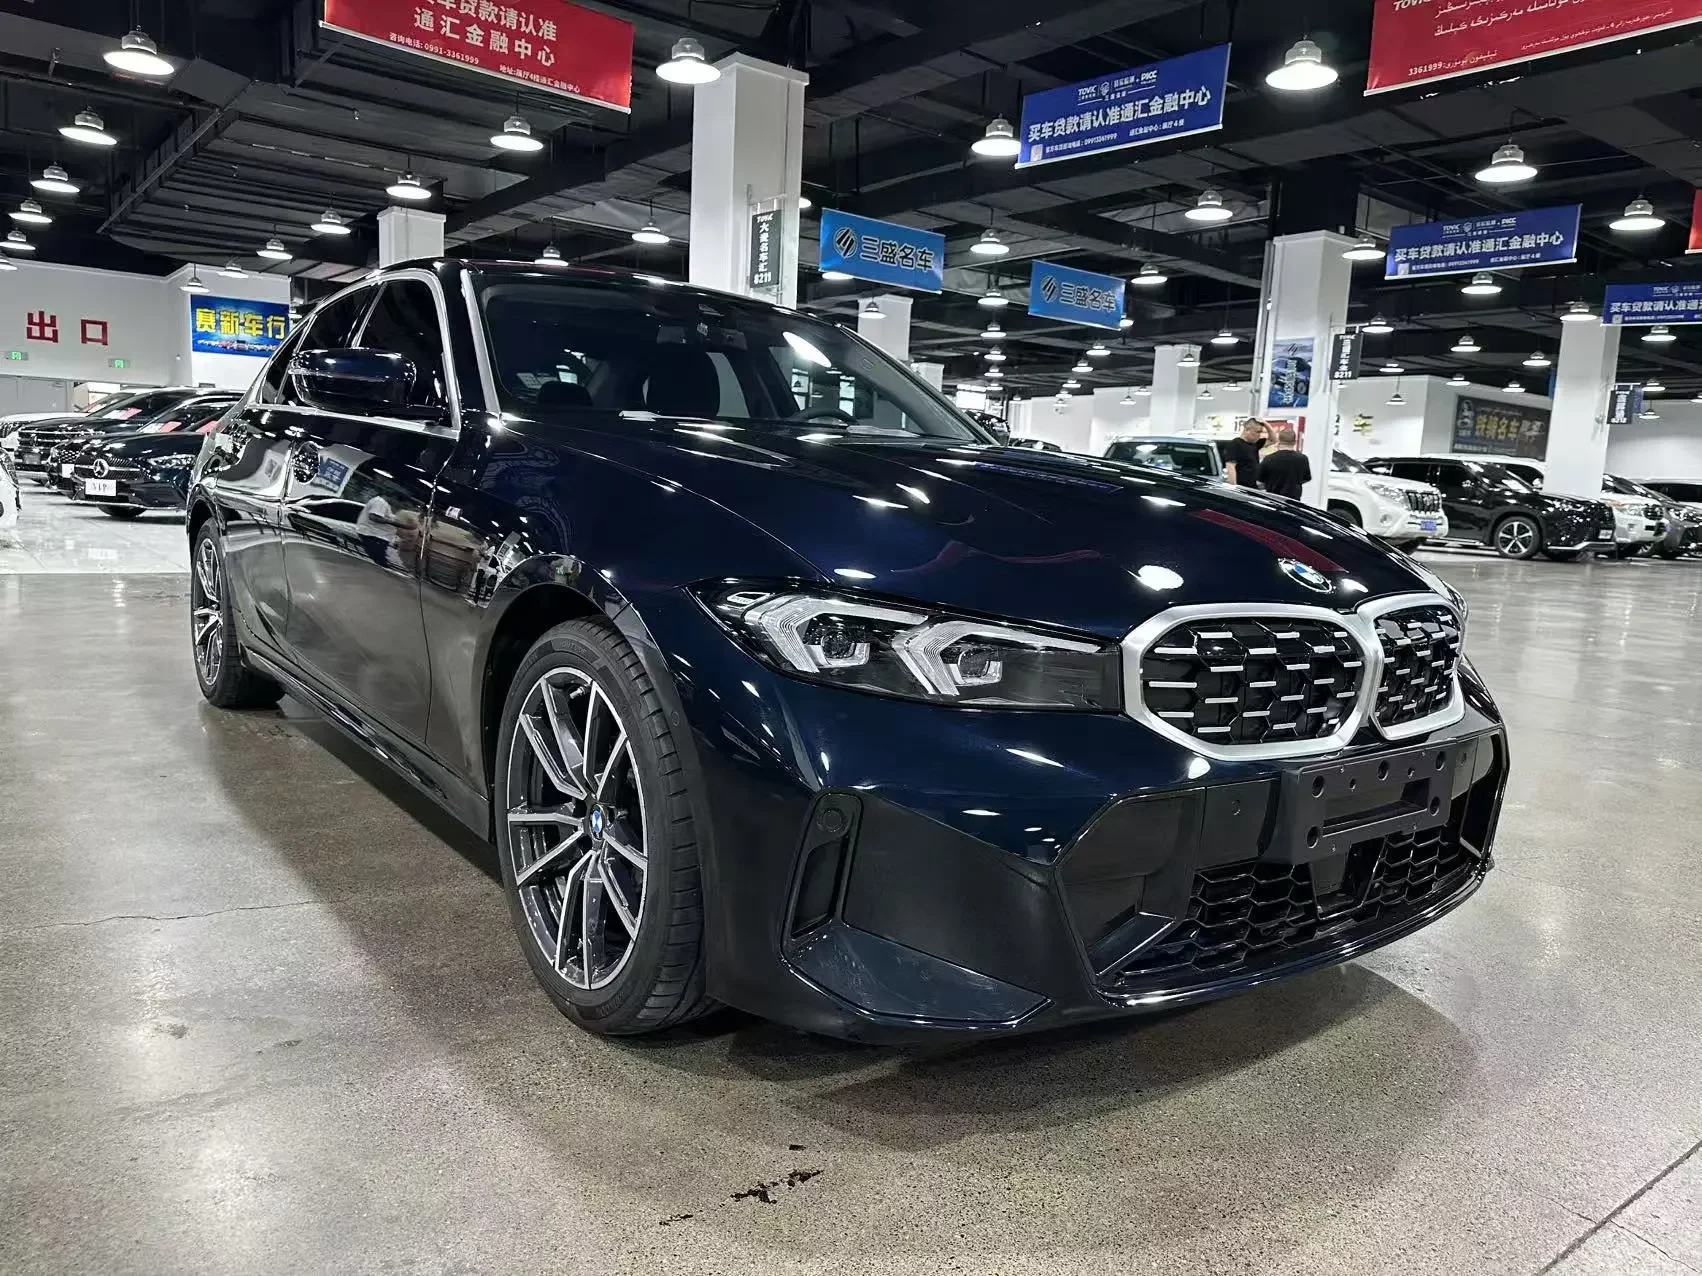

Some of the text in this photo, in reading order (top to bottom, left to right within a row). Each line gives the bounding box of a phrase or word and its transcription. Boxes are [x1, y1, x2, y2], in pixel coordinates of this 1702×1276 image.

[414, 7, 555, 67] 通汇金融中心
[428, 0, 557, 41] 贷款请认准
[1028, 85, 1211, 142] 买车贷款请认准通汇金融中心
[861, 235, 934, 273] 三盛名车
[1395, 231, 1565, 262] 买车贷款请认准通汇金融中心
[1059, 282, 1117, 313] 三盛名车
[1610, 300, 1702, 313] 买车贷款请认准通
[26, 311, 109, 346] 出口
